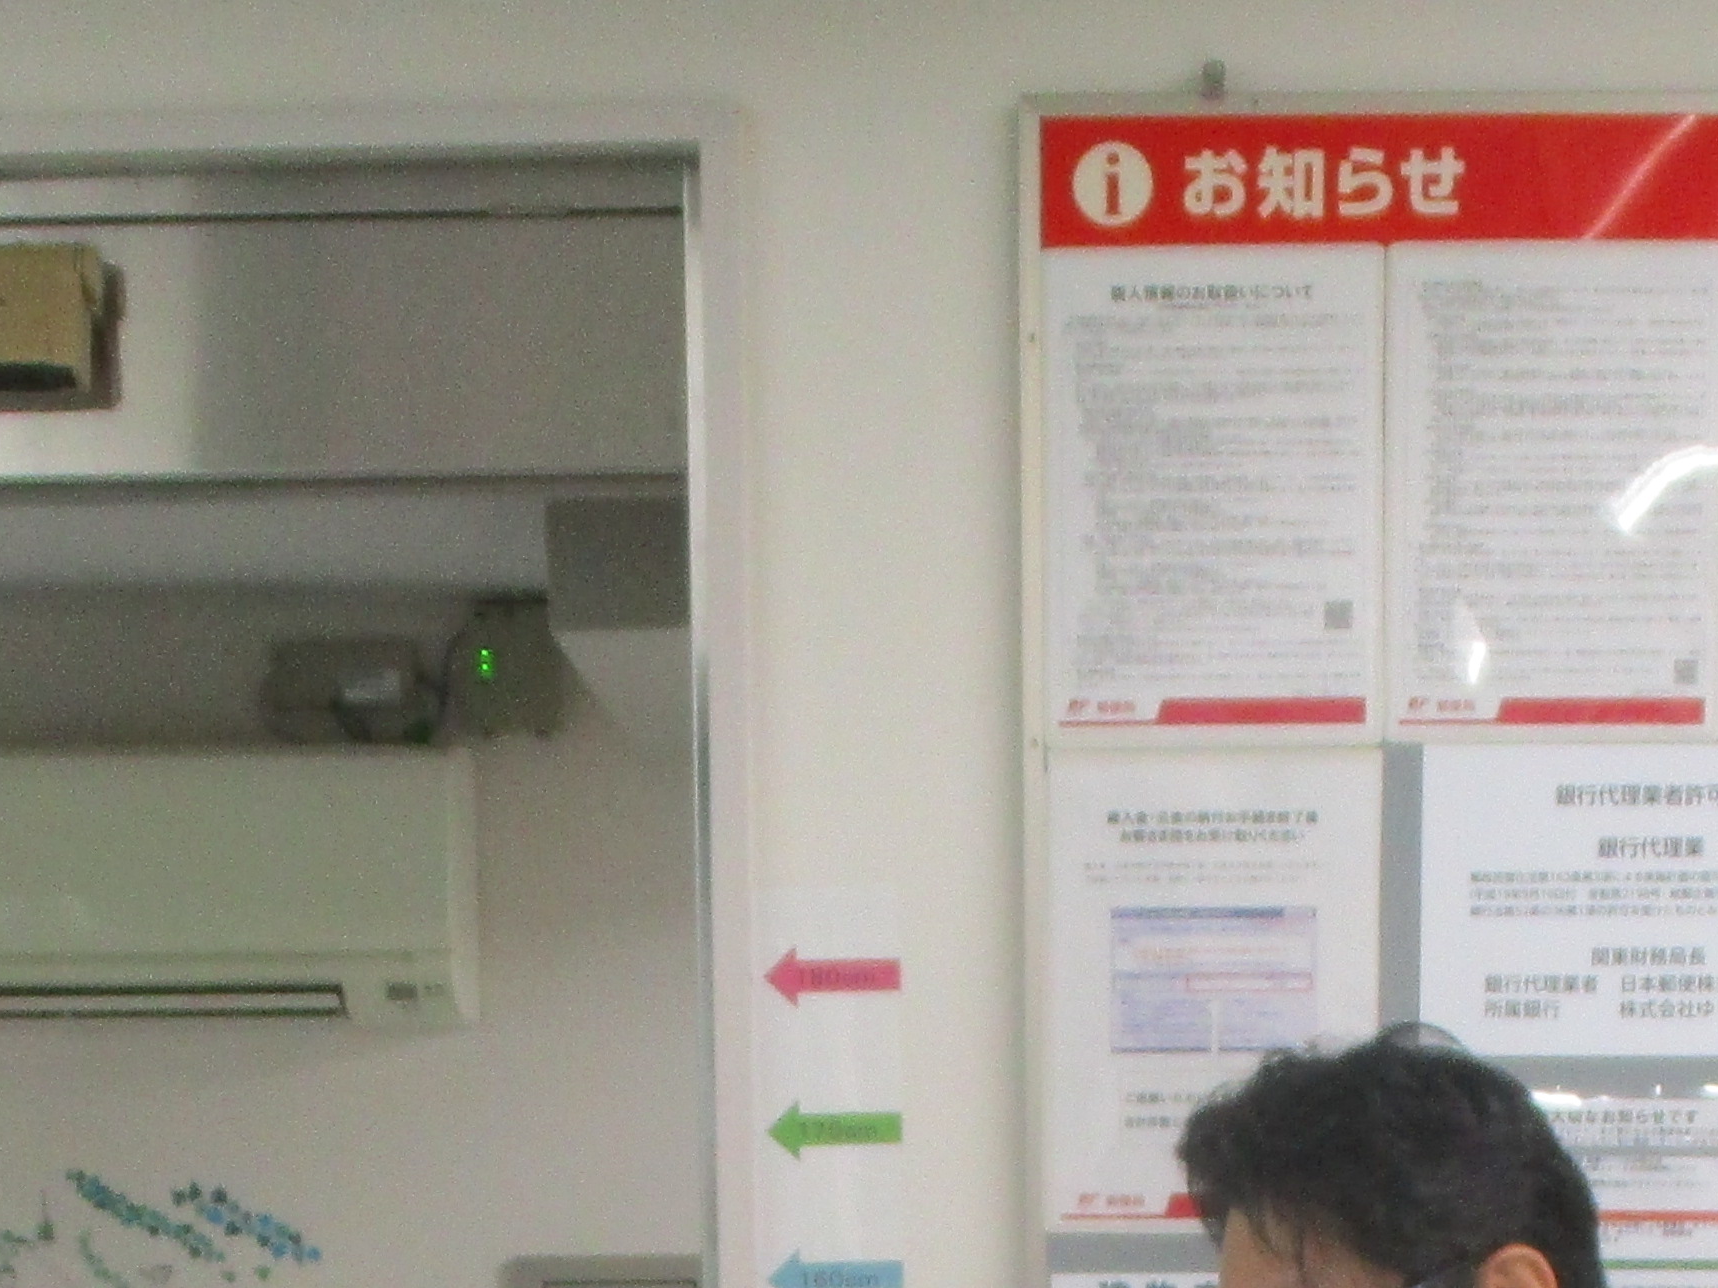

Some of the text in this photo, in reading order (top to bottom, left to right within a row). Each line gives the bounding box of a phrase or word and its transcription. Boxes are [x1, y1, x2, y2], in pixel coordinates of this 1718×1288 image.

[1184, 146, 1466, 220] お知らせ
[1597, 835, 1705, 860] 銀行代理業
[1590, 946, 1707, 967] 関東財務局長
[1484, 974, 1599, 994] 銀行代理業者
[1484, 999, 1560, 1020] 所属銀行
[801, 1269, 879, 1288] 160cm
